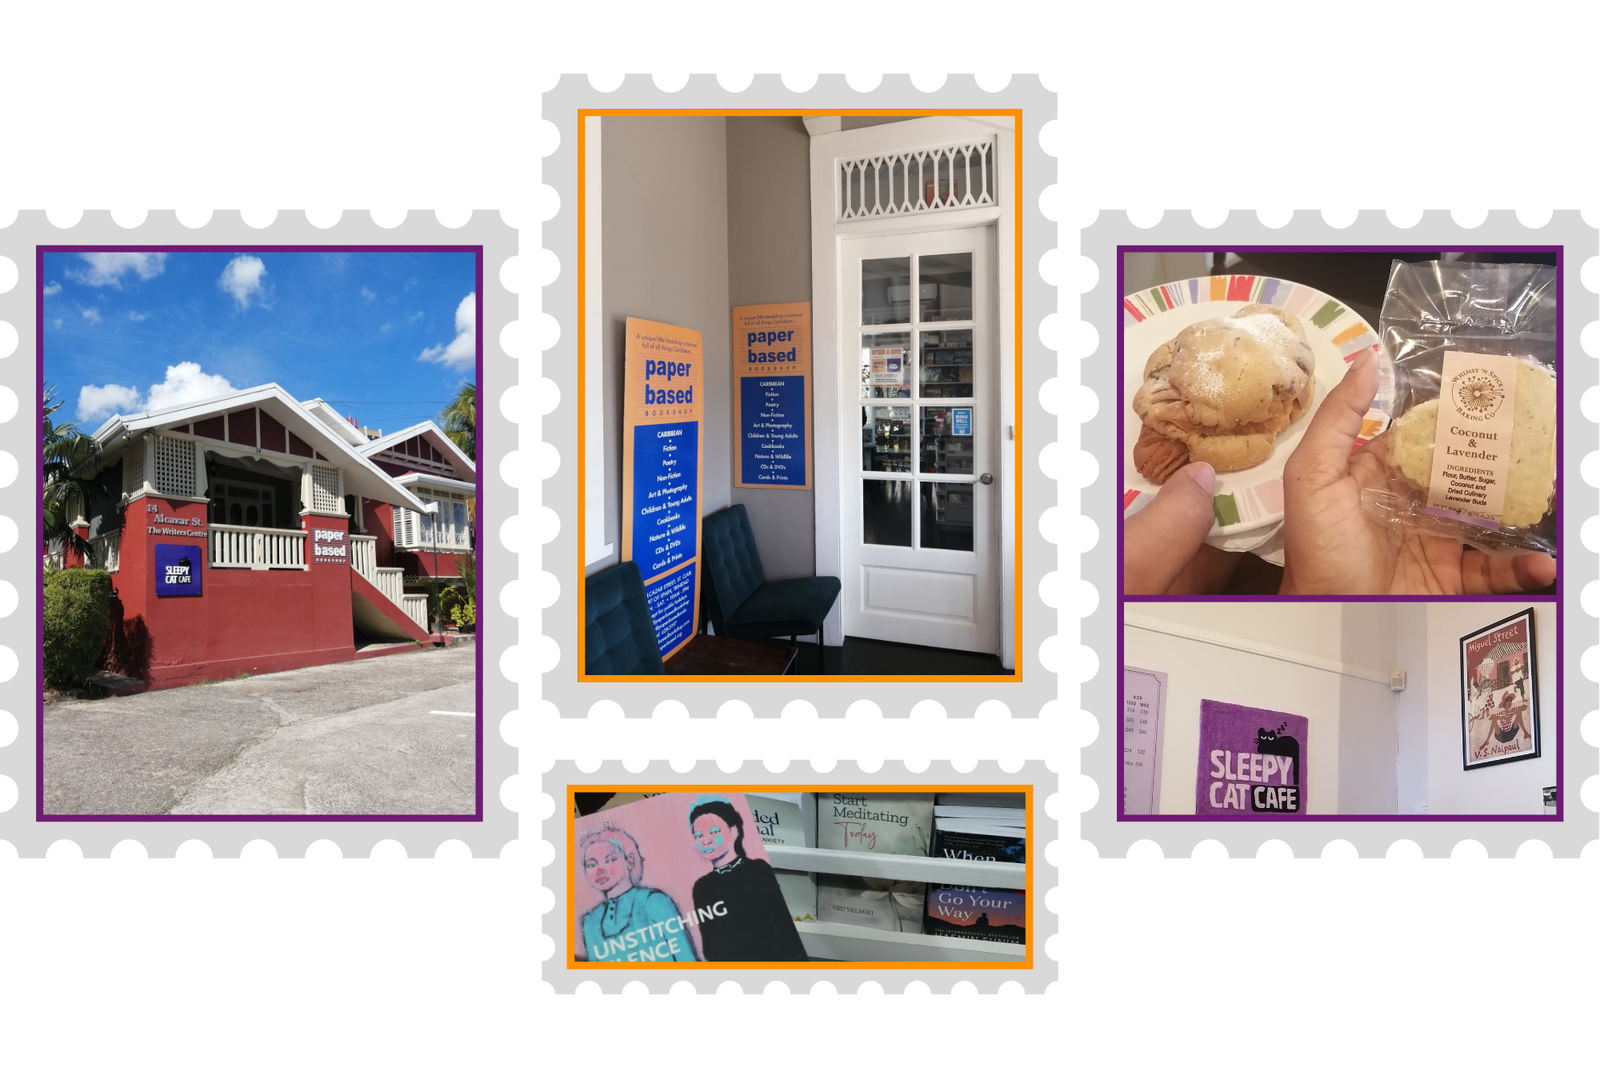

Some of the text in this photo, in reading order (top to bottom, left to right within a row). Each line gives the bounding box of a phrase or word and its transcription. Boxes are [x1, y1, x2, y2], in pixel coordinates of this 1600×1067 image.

[666, 337, 682, 346] bookshop
[748, 330, 794, 347] paper
[661, 344, 672, 353] things
[748, 347, 796, 363] based
[646, 360, 691, 381] paper
[1452, 368, 1479, 383] WHIMSY
[1490, 371, 1503, 387] SPICE
[645, 384, 692, 405] based
[1456, 407, 1495, 421] BAKING CO
[657, 429, 683, 438] CARIBBEAN
[1450, 426, 1498, 440] Coconut
[663, 444, 677, 452] Fiction
[1468, 438, 1477, 448] &
[1446, 446, 1498, 461] Lavender
[657, 472, 681, 482] Non-Fiction
[1447, 464, 1493, 476] INGREDIENTS
[1442, 471, 1496, 485] Flour, Butter, Sugar,
[1451, 480, 1474, 489] Coconut
[648, 491, 656, 499] Art
[662, 483, 688, 495] Photography
[1464, 490, 1487, 499] Culinary
[1446, 495, 1471, 503] Lavender
[147, 504, 158, 512] 14
[641, 505, 661, 515] Children
[667, 500, 680, 508] Young
[154, 514, 203, 527] Alcazar St.
[657, 513, 680, 525] Cookbooks
[162, 528, 186, 536] Writers
[187, 529, 207, 537] Centre
[315, 530, 344, 542] paper
[649, 533, 665, 542] Nature
[671, 524, 686, 534] Wildlife
[315, 543, 346, 556] based
[670, 540, 681, 549] DVDs
[653, 559, 666, 570] Cards
[671, 553, 683, 562] Prints
[165, 566, 190, 575] SLEEPY
[165, 575, 178, 584] CAT
[1468, 625, 1518, 653] Miguel Street
[1474, 738, 1520, 759] V. S. Naipaul
[1210, 749, 1293, 785] SLEEPY
[833, 793, 867, 807] Start
[1209, 782, 1296, 810] CAT CAFE
[833, 806, 909, 827] Meditating
[833, 821, 879, 850] Today
[944, 848, 996, 861] When
[941, 884, 989, 894] Dont
[939, 893, 1012, 908] Go Your
[847, 907, 874, 916] VALMIKI
[938, 906, 973, 921] Way
[593, 901, 728, 960] UNSTITCHING
